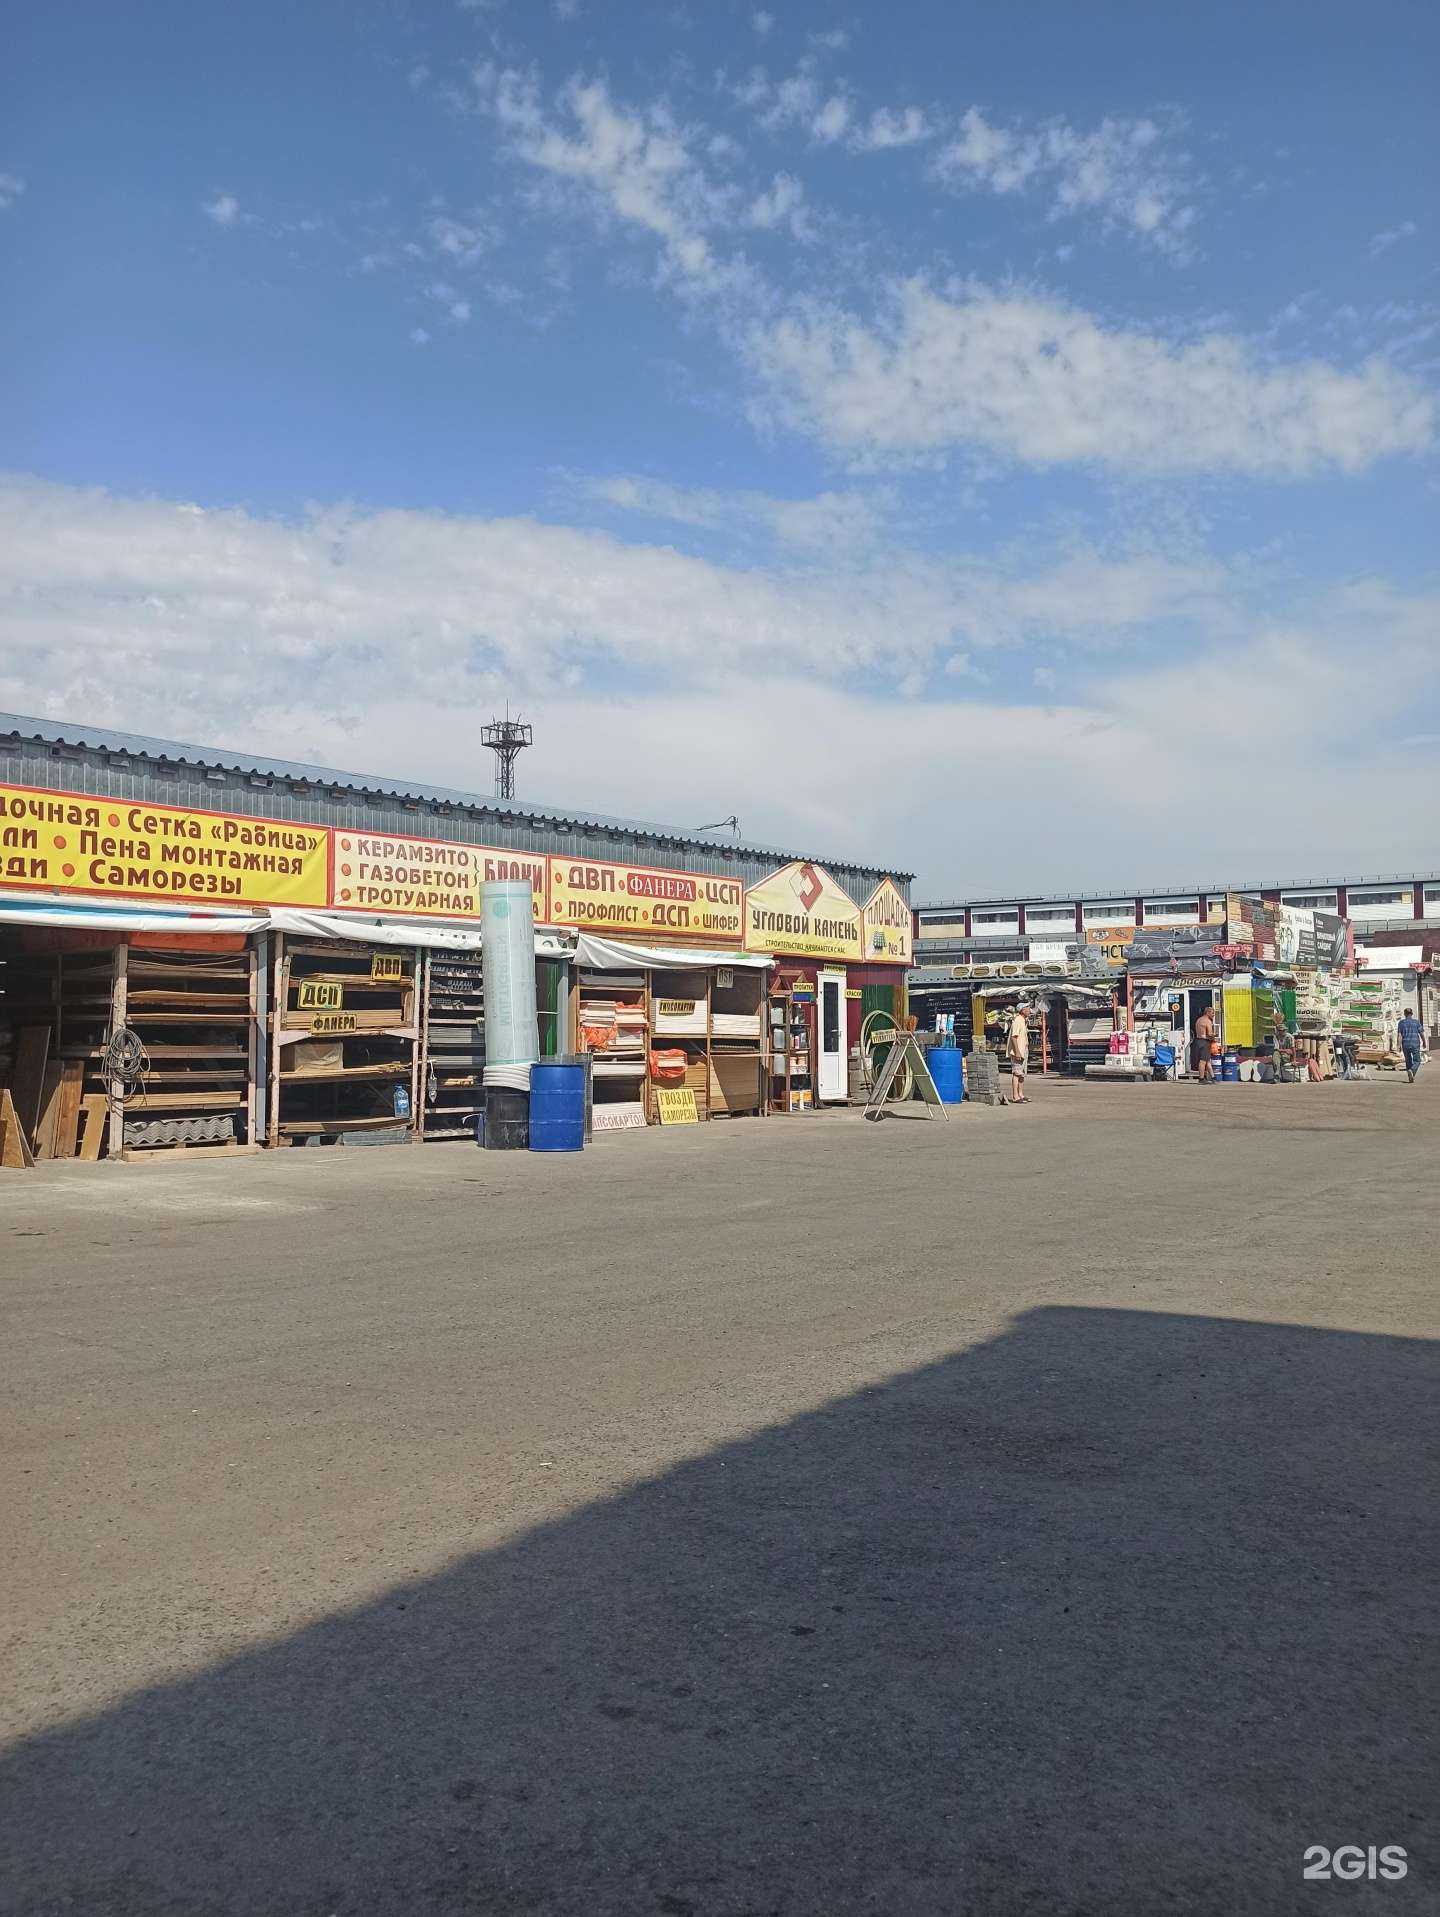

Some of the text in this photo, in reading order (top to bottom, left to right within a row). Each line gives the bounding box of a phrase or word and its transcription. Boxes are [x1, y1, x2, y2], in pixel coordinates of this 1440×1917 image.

[128, 808, 201, 839] Сетка
[211, 821, 318, 851] «Рабица»
[80, 830, 151, 860] Пена
[162, 844, 303, 875] монтажная
[357, 839, 469, 867] КЕРАМЗИТО
[0, 856, 242, 895] ди Саморезы
[359, 863, 469, 889] ГАЗОБЕТОН
[567, 866, 740, 906] ДВП ФАНЕРА ЦСП
[357, 886, 474, 911] ТРОТУАРНАЯ
[868, 889, 909, 928] ПЛОЩАДКА
[568, 901, 739, 931] ПРОФЛИСТ ДСП ШИФЕР
[752, 910, 858, 941] УГЛОВОЙ КАМЕНЬ
[302, 984, 339, 1005] ДСП
[313, 1017, 355, 1031] ФАНЕРА
[660, 1090, 694, 1106] ГВОЗДИ
[592, 1113, 646, 1129] ИПСОКАРТОН
[662, 1109, 698, 1123] САМОРЕЗЫ
